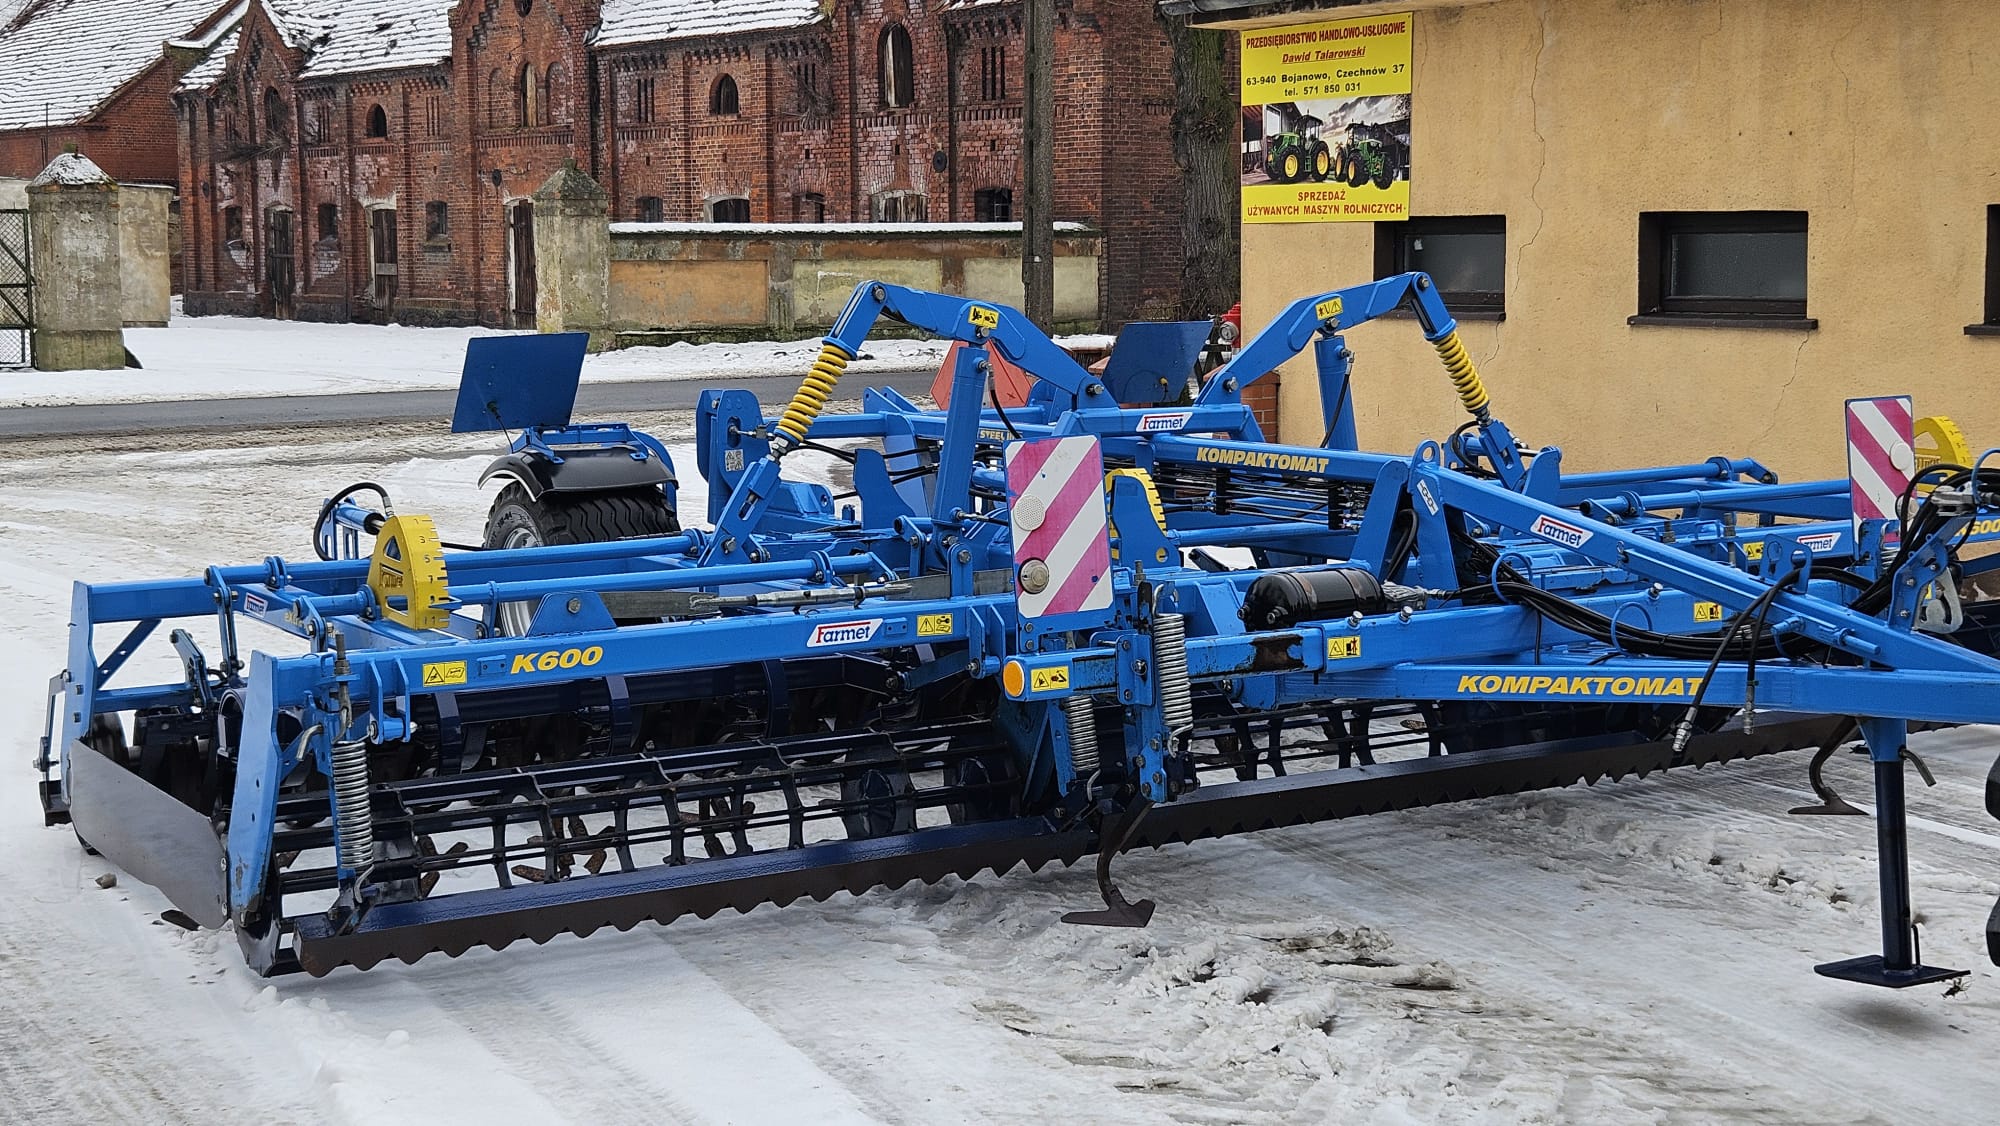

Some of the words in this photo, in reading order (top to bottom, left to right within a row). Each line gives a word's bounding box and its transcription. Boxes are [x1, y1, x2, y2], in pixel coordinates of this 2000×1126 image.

[1246, 31, 1317, 49] PRZEDSIĘBIORSTWO
[1319, 21, 1406, 41] HANDLOWO-USŁUGOWE
[1282, 51, 1311, 63] Dawid
[1315, 46, 1366, 60] Talarowski
[1246, 75, 1276, 86] 63-940
[1281, 73, 1330, 84] Bojanowo,
[1336, 66, 1387, 78] Czechnów
[1392, 63, 1405, 74] 37
[1284, 88, 1298, 97] tel.
[1303, 86, 1319, 95] 571
[1324, 84, 1340, 94] 850
[1345, 82, 1361, 92] 031
[1298, 189, 1346, 202] SPRZEDAŻ
[1247, 204, 1299, 217] UŻYWANYCH
[1303, 204, 1340, 215] MASZYN
[1343, 203, 1402, 214] ROLNICZYCH
[1143, 414, 1184, 430] Farmet
[1197, 446, 1329, 474] KOMPAKTOMAT
[419, 535, 426, 544] 3
[1537, 516, 1584, 547] Farmet
[424, 554, 431, 563] 5
[815, 621, 871, 644] Farmet
[510, 646, 604, 675] K600
[1457, 675, 1704, 696] KOMPAKTOMAT
